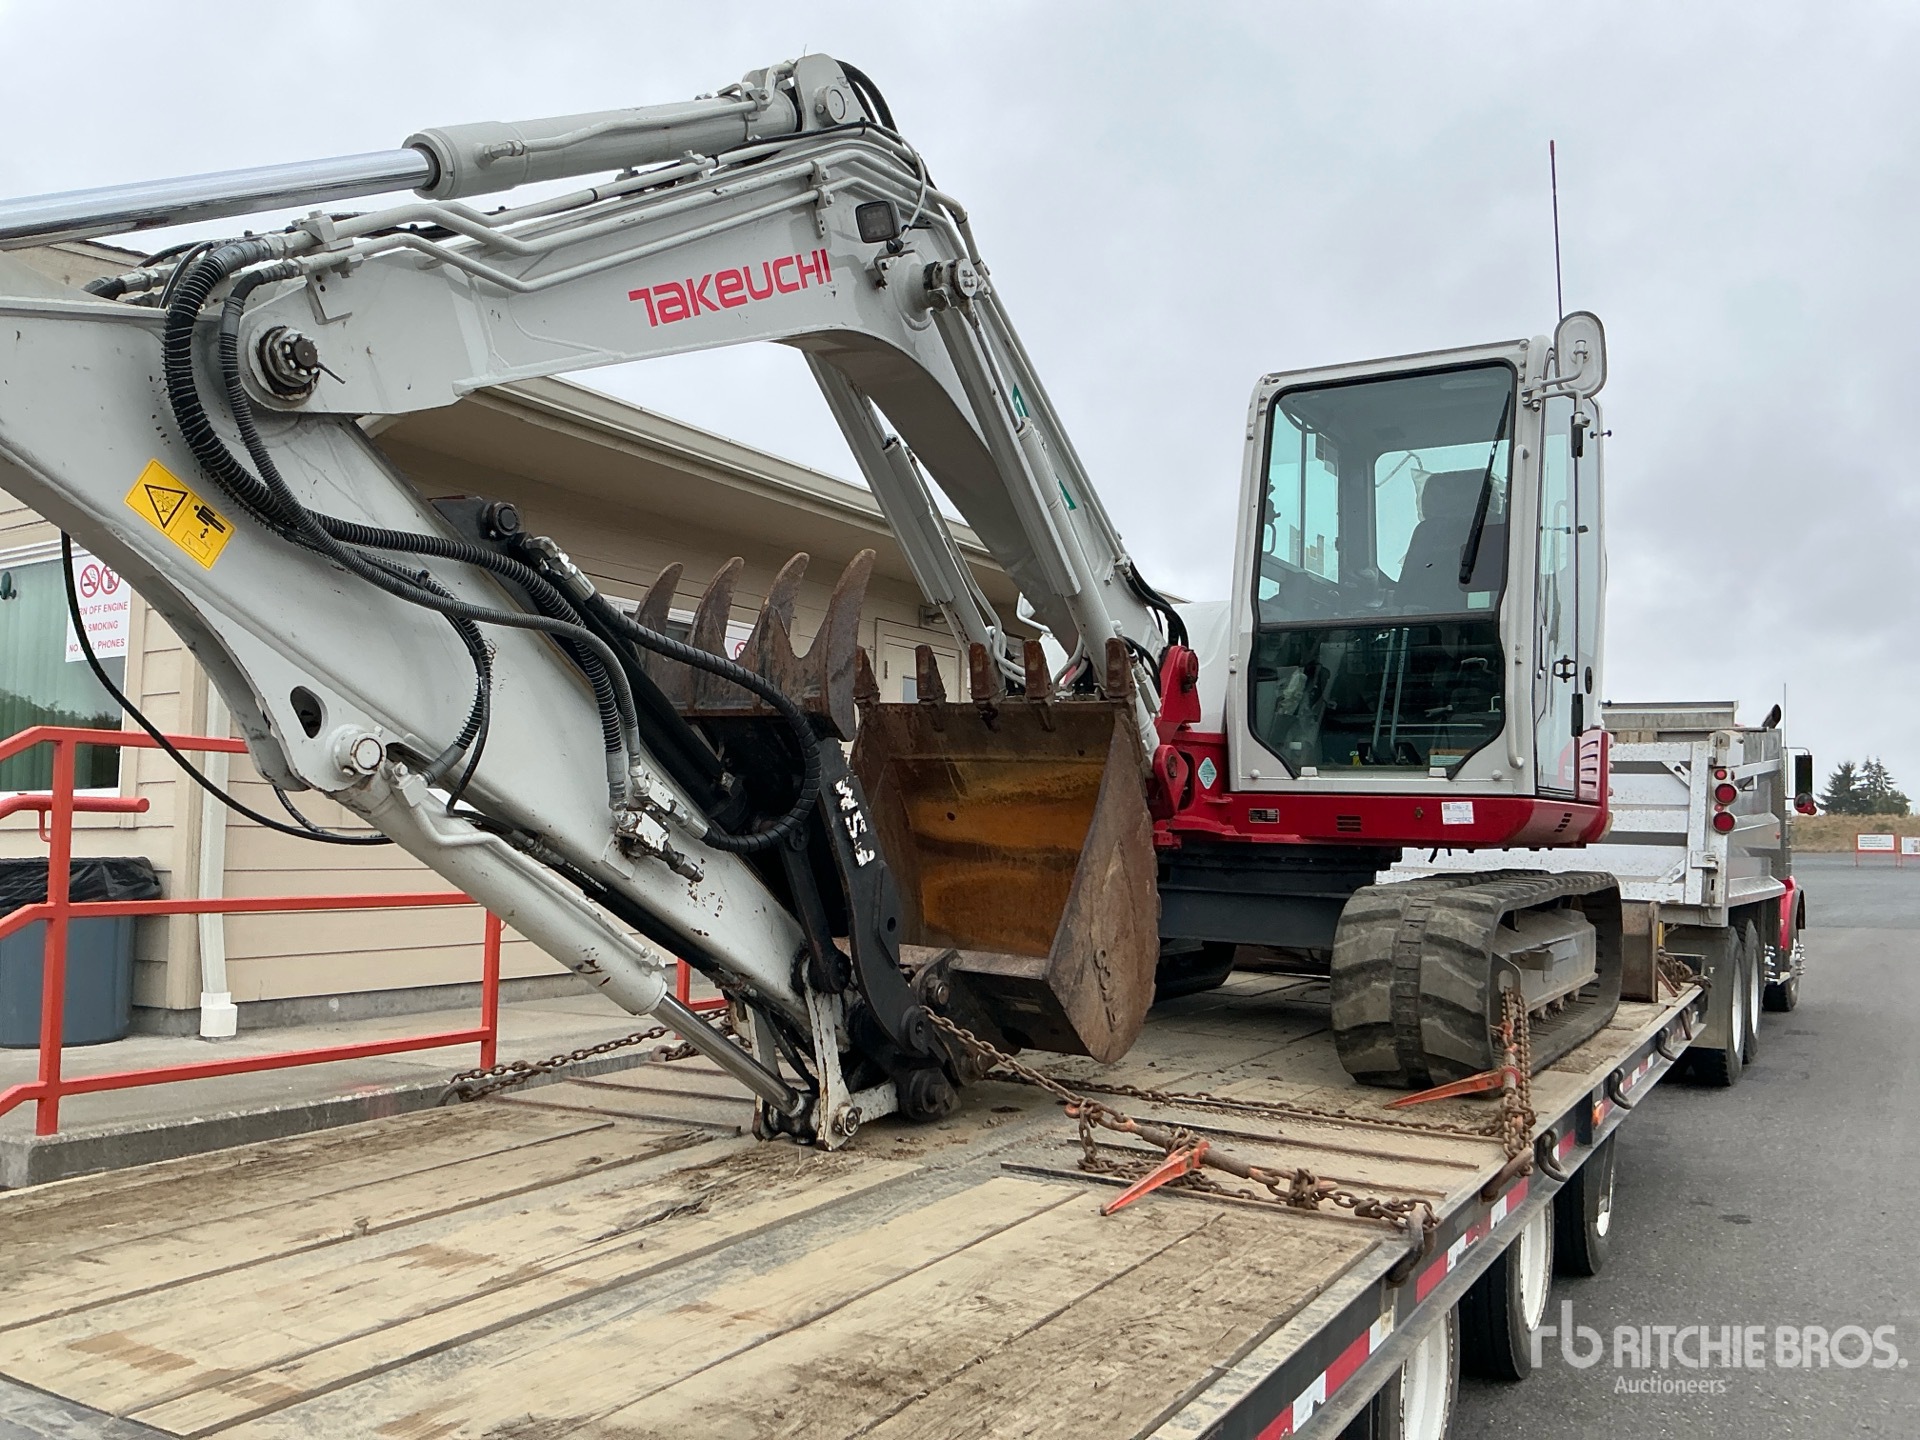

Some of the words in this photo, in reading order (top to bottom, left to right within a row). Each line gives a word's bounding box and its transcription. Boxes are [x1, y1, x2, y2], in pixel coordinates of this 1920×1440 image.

[89, 603, 102, 615] OFF
[103, 601, 128, 613] ENGINE
[88, 620, 119, 632] SMOKING
[69, 643, 78, 652] NO
[97, 638, 125, 650] PHONES
